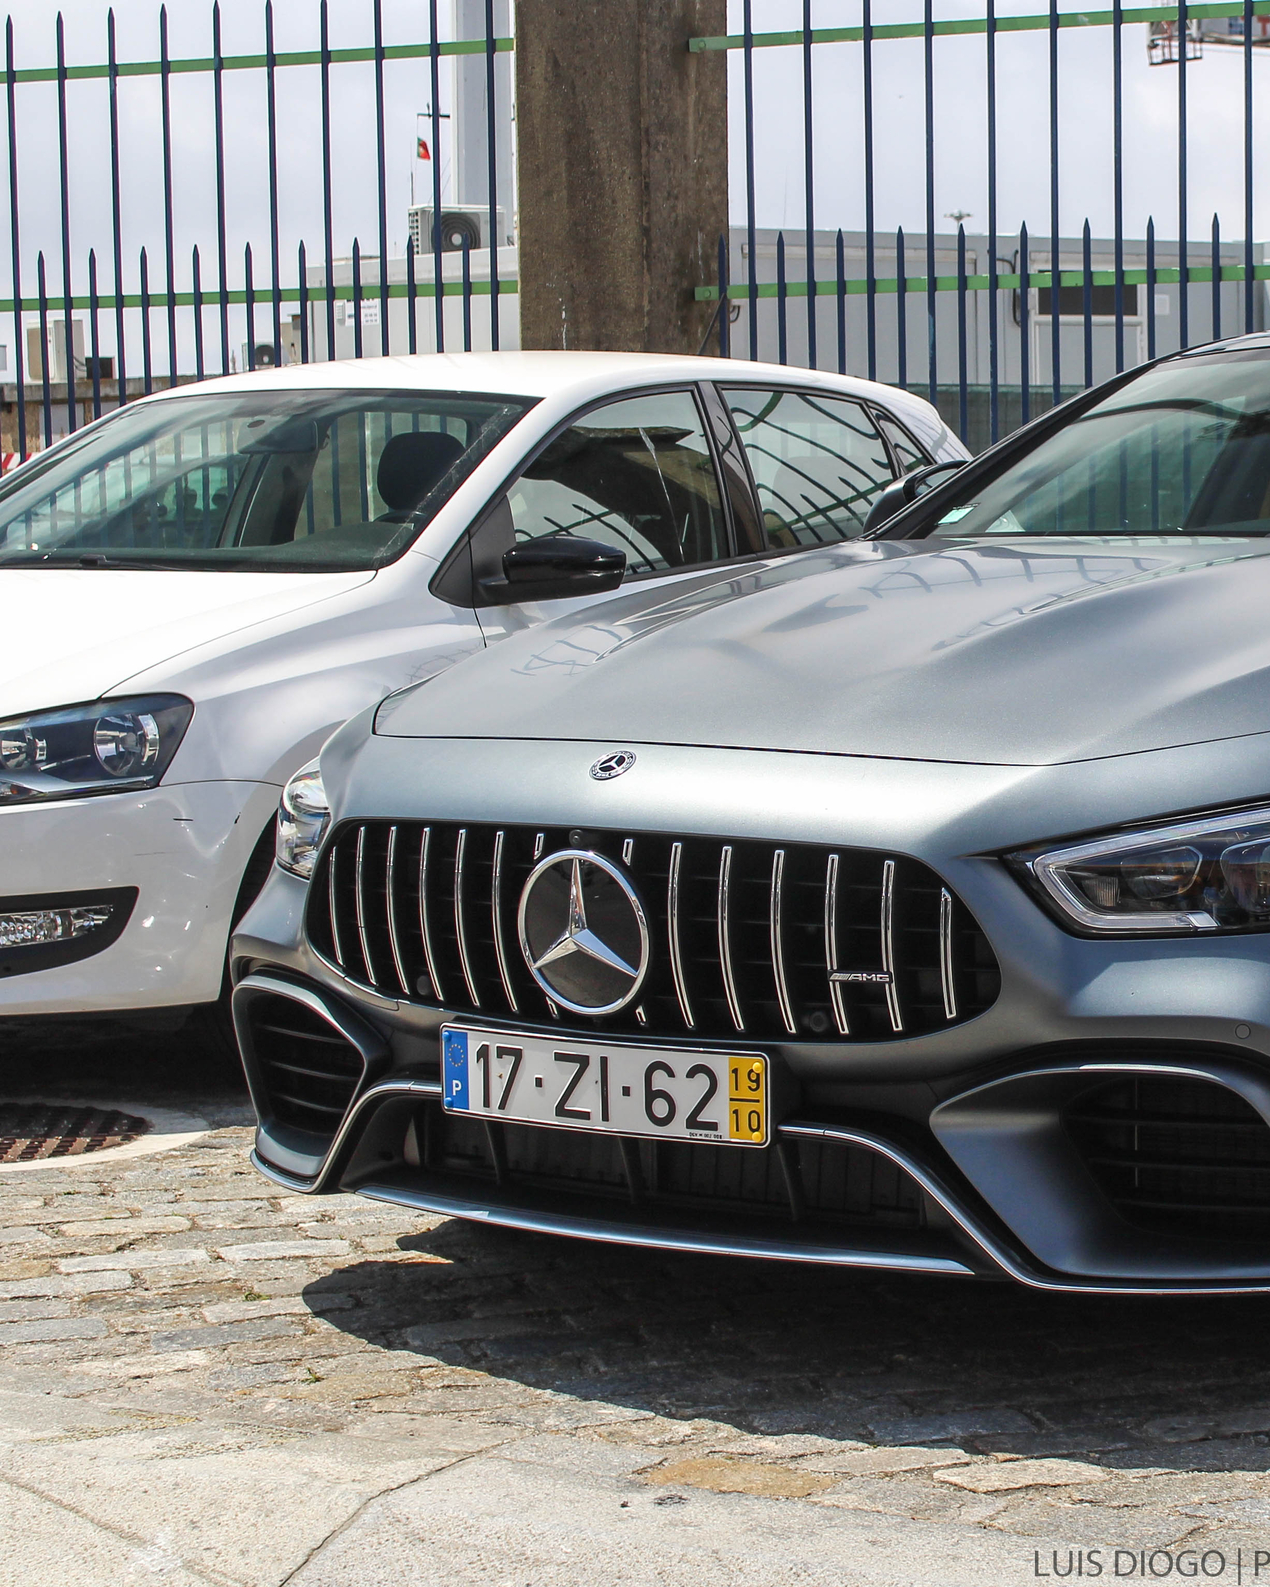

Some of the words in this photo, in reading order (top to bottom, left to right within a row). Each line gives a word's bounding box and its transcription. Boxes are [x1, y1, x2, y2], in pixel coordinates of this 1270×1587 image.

[849, 974, 890, 982] AMG
[452, 1079, 462, 1096] P
[731, 1068, 762, 1092] 19
[732, 1110, 761, 1133] 10
